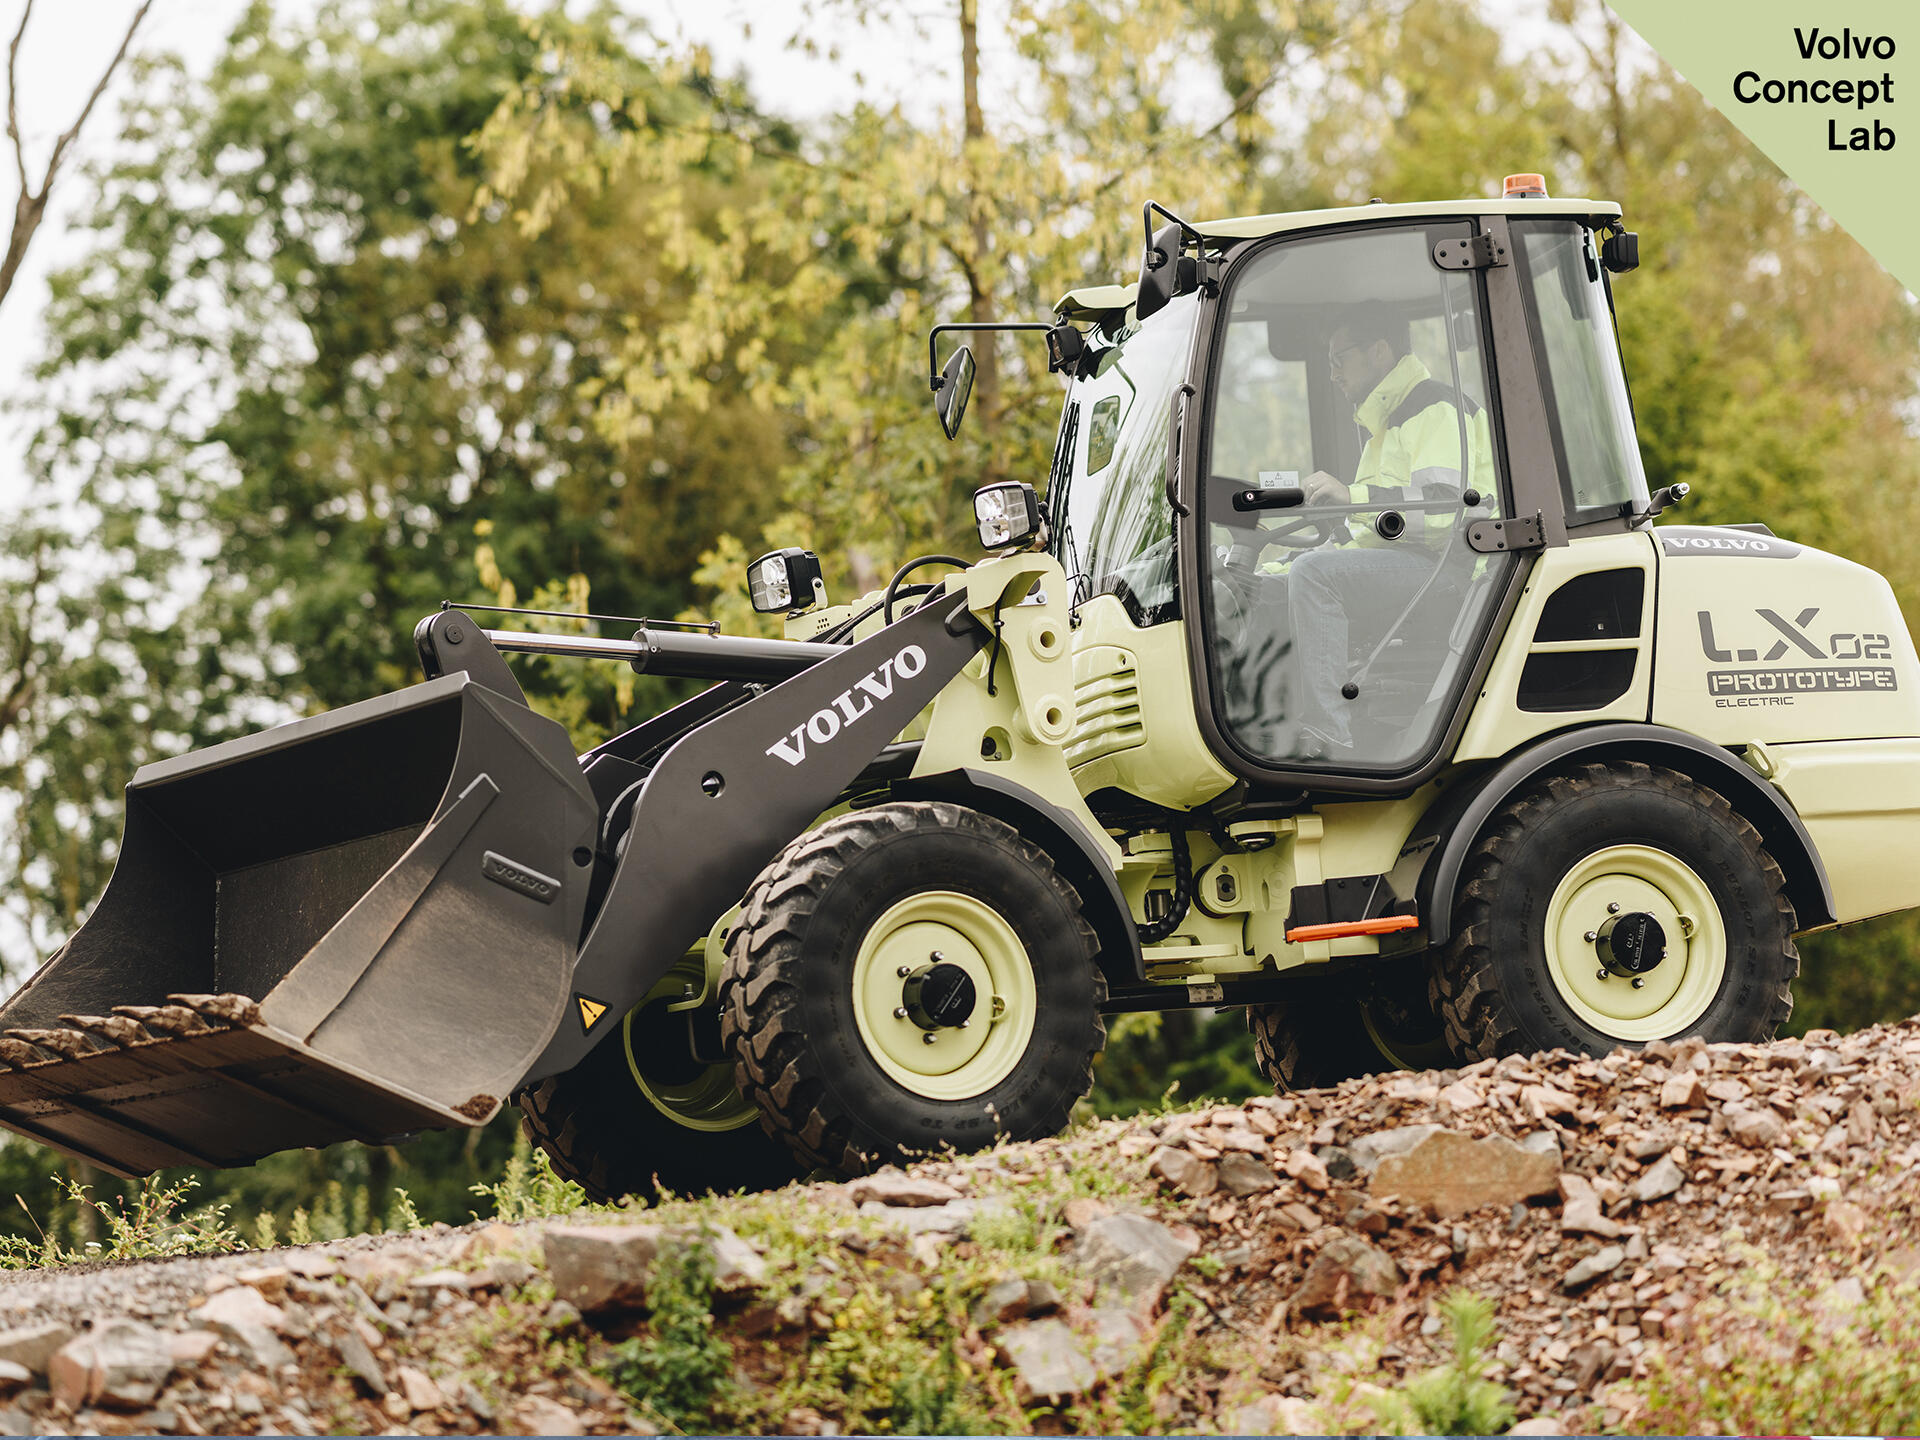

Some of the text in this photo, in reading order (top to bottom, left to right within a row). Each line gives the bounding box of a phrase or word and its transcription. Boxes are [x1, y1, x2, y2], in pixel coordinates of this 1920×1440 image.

[1664, 537, 1770, 551] VOLVO
[1711, 670, 1895, 693] PROTOTYPE
[765, 644, 928, 767] VOLVO
[1715, 696, 1795, 708] ELECTRIC
[493, 860, 551, 895] VOLVO
